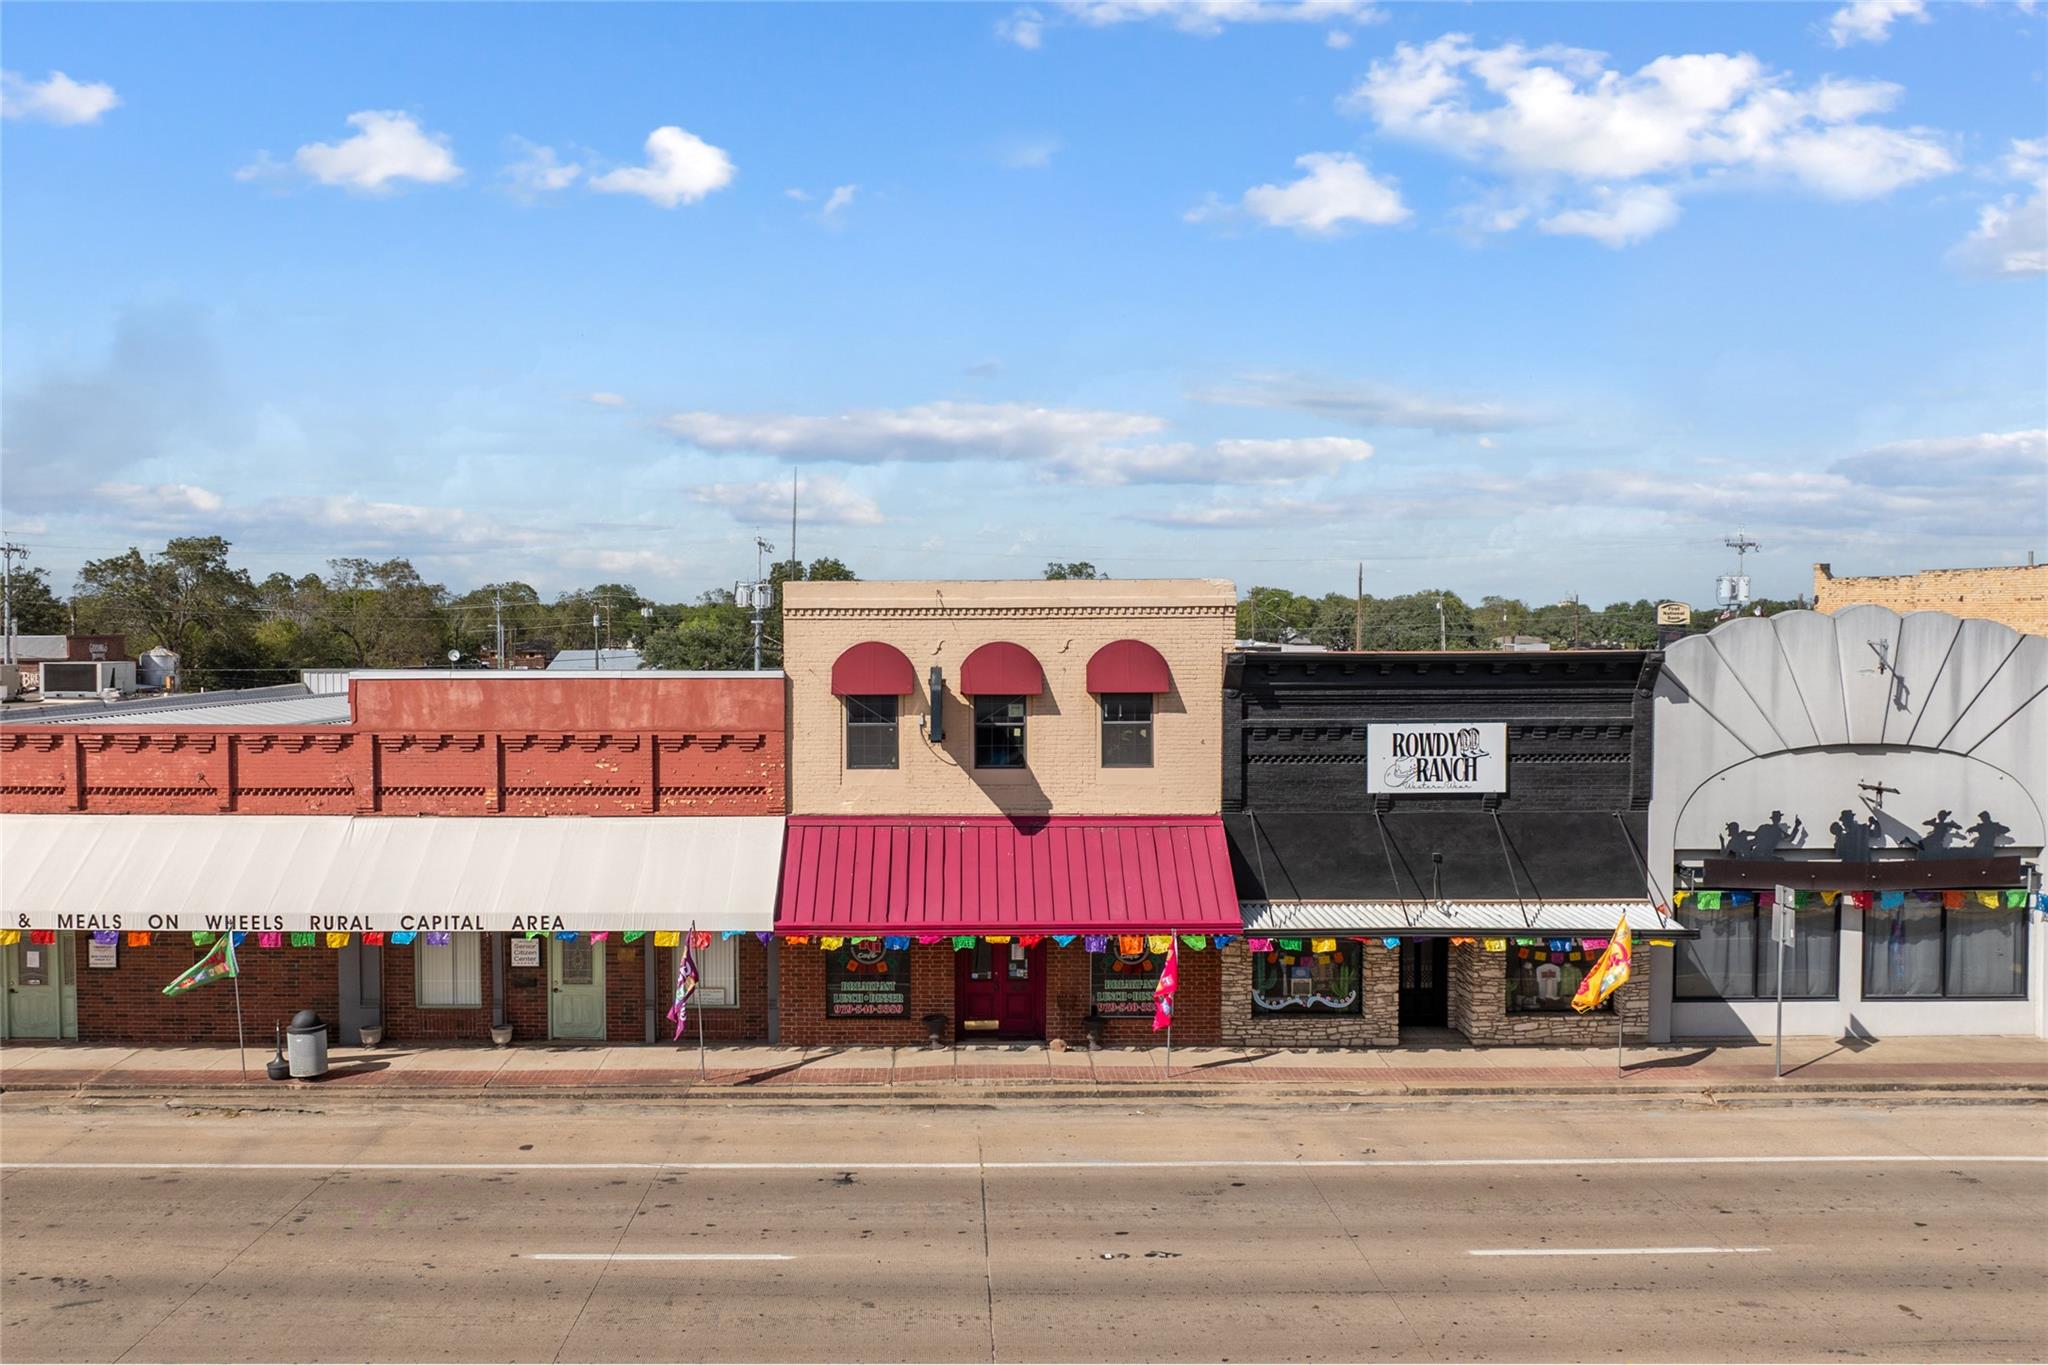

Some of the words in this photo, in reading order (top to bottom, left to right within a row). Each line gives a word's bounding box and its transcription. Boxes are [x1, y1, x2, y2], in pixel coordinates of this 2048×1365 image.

[1393, 732, 1461, 757] ROWDY
[1416, 758, 1477, 782] RANCH
[18, 913, 31, 928] &
[57, 914, 122, 929] MEALS
[148, 915, 178, 929] ON
[205, 915, 283, 929] WHEELS
[310, 915, 373, 930] RURAL
[400, 915, 484, 930] CAPITAL
[511, 915, 564, 930] AREA
